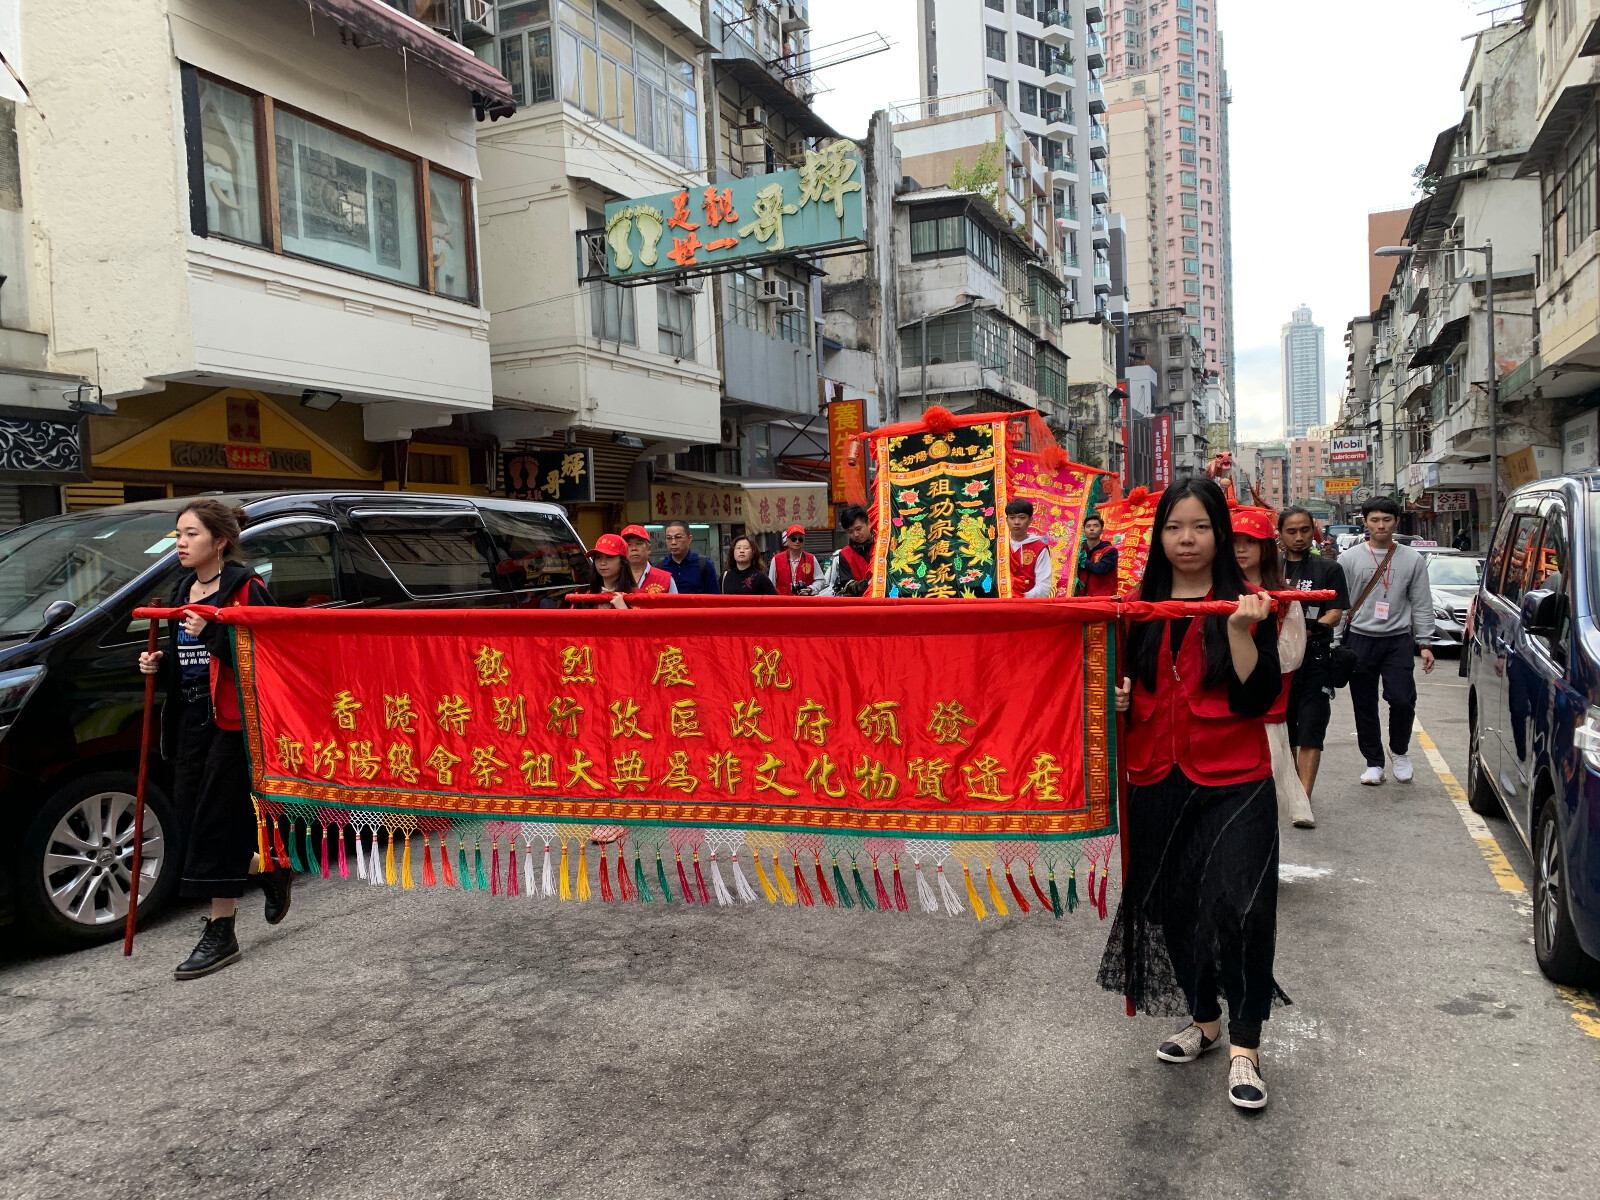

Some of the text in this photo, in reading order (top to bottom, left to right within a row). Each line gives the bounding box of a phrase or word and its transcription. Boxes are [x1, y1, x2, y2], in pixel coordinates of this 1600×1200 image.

[1155, 431, 1163, 481] LEASING
[1333, 439, 1363, 450] Mobil
[473, 644, 794, 690] 熱烈慶祝
